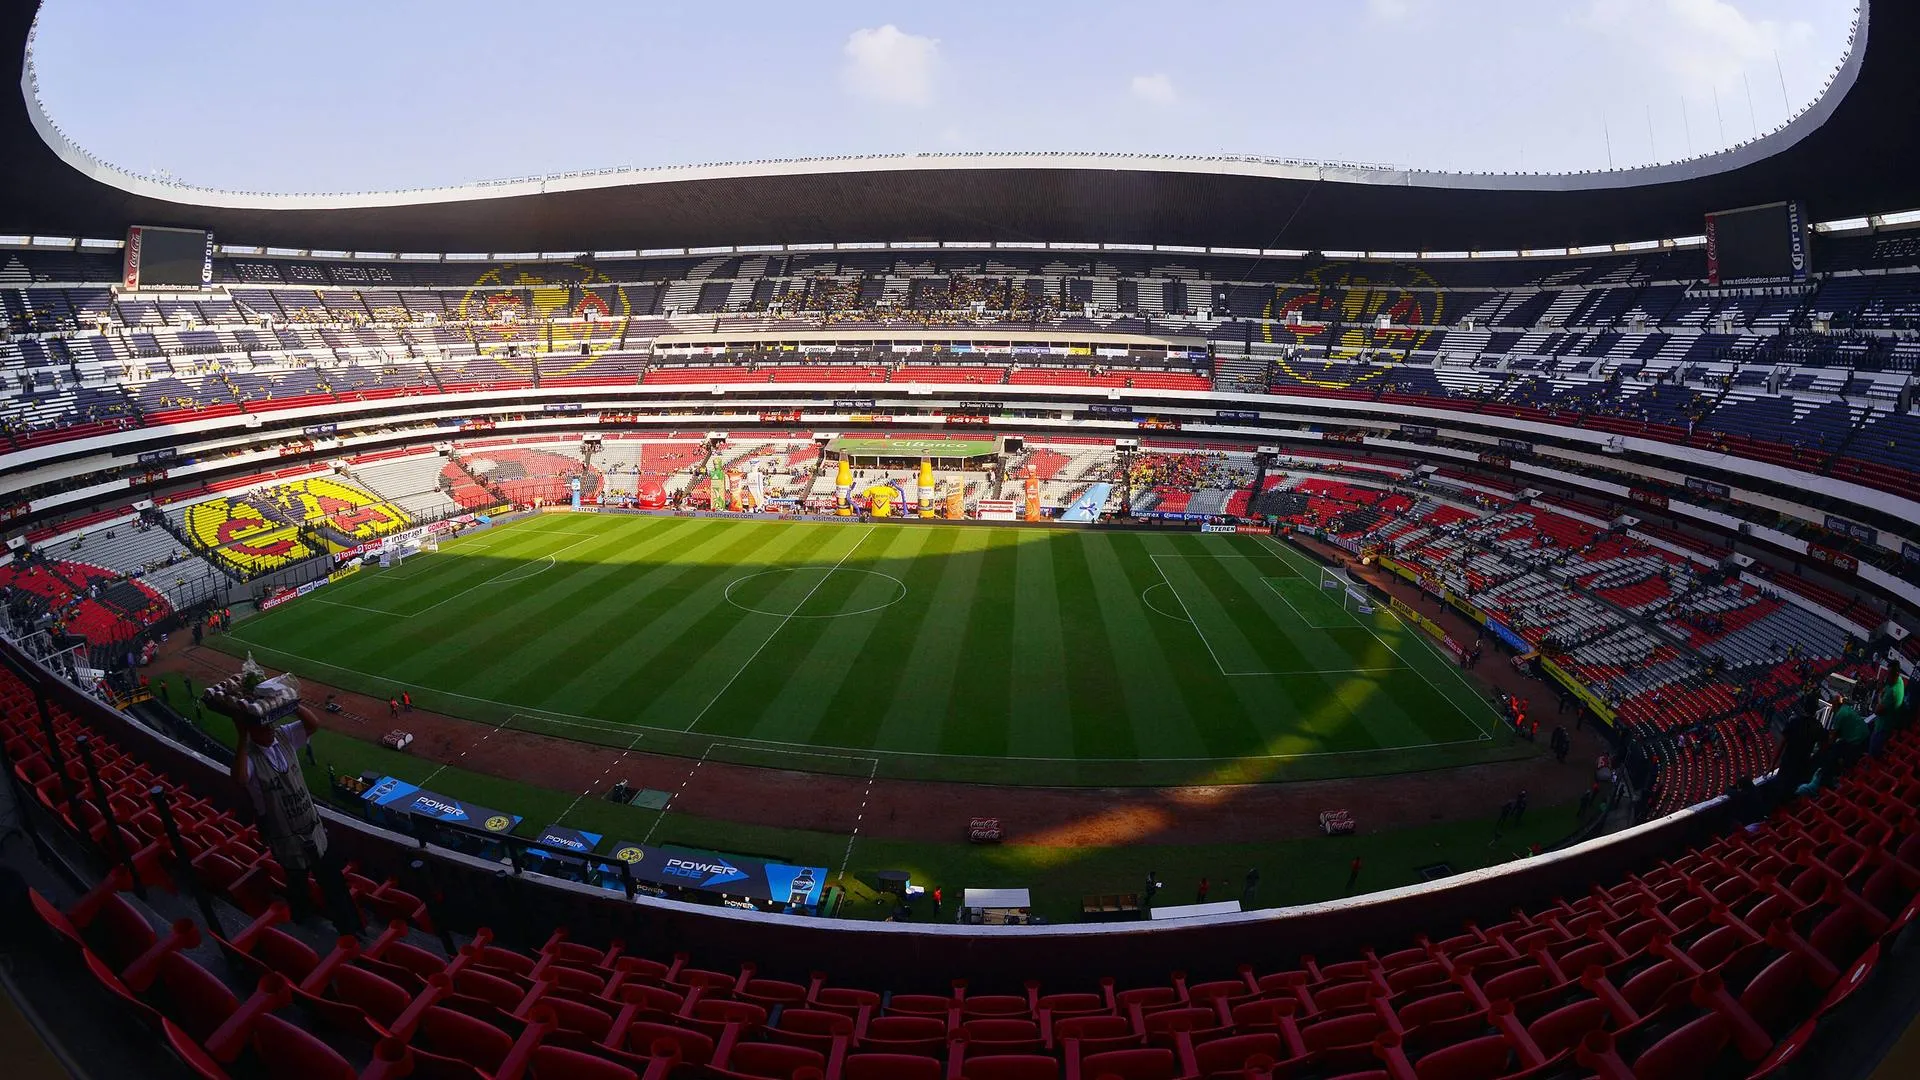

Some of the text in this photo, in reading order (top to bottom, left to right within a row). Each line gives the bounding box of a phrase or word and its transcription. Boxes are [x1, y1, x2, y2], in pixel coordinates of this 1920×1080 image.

[1789, 203, 1804, 270] Corona
[129, 233, 140, 268] Coca-Cola
[202, 233, 213, 282] Corona
[391, 528, 423, 543] interjet
[364, 541, 382, 550] TOTAL
[340, 549, 358, 559] TOTAL
[263, 591, 297, 610] Office DEPOT
[416, 796, 464, 817] POWER
[971, 819, 1000, 828] Coca-Cola
[545, 834, 584, 849] POWER
[971, 829, 1001, 839] Coca-Cola
[661, 867, 704, 879] ADE
[667, 858, 739, 876] POWER
[636, 884, 664, 894] POWER
[724, 900, 754, 909] POWER
